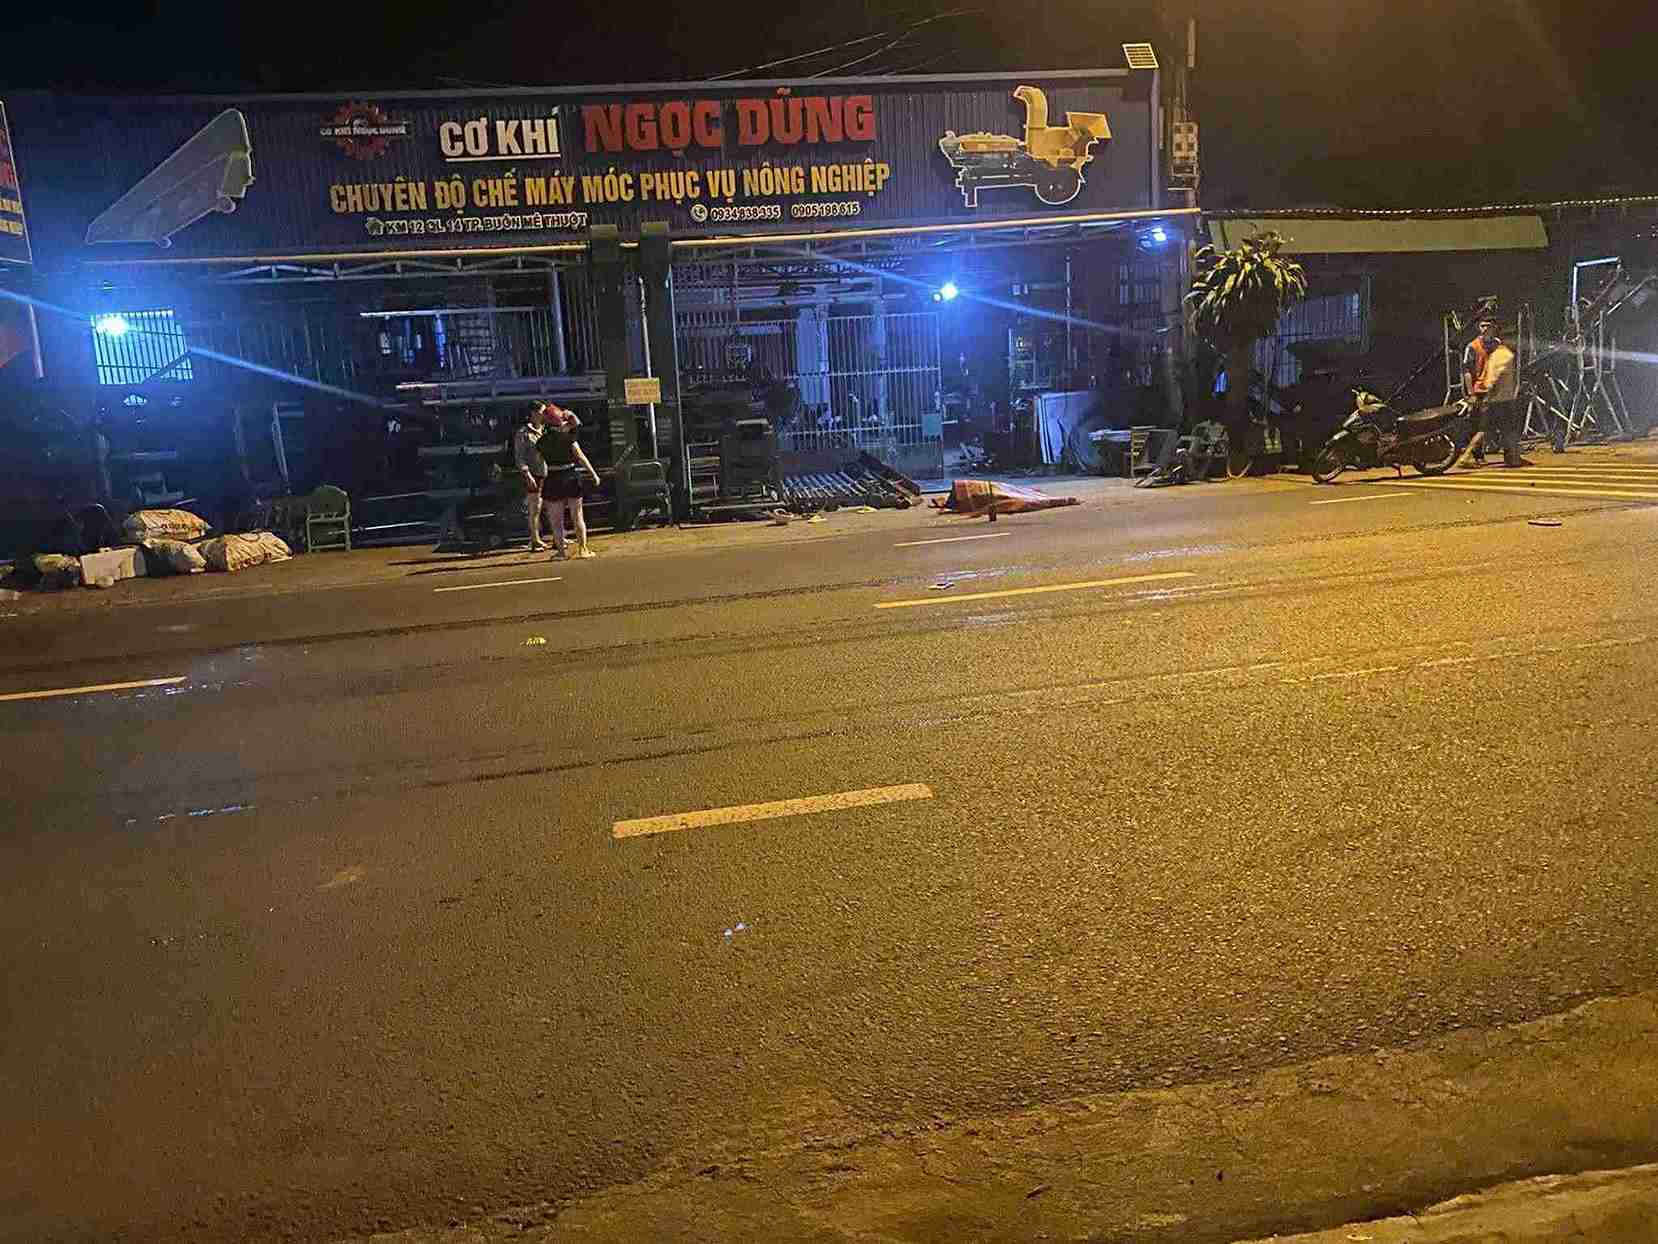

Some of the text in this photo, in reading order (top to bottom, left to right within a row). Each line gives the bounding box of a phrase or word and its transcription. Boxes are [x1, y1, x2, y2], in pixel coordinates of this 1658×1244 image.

[440, 88, 876, 157] CƠ KHÍ NGỌC DŨNG
[330, 158, 890, 214] CHUYÊN ĐỘ CHẾ MÁY MÓC PHỤC VỤ NÔNG NGHIỆP
